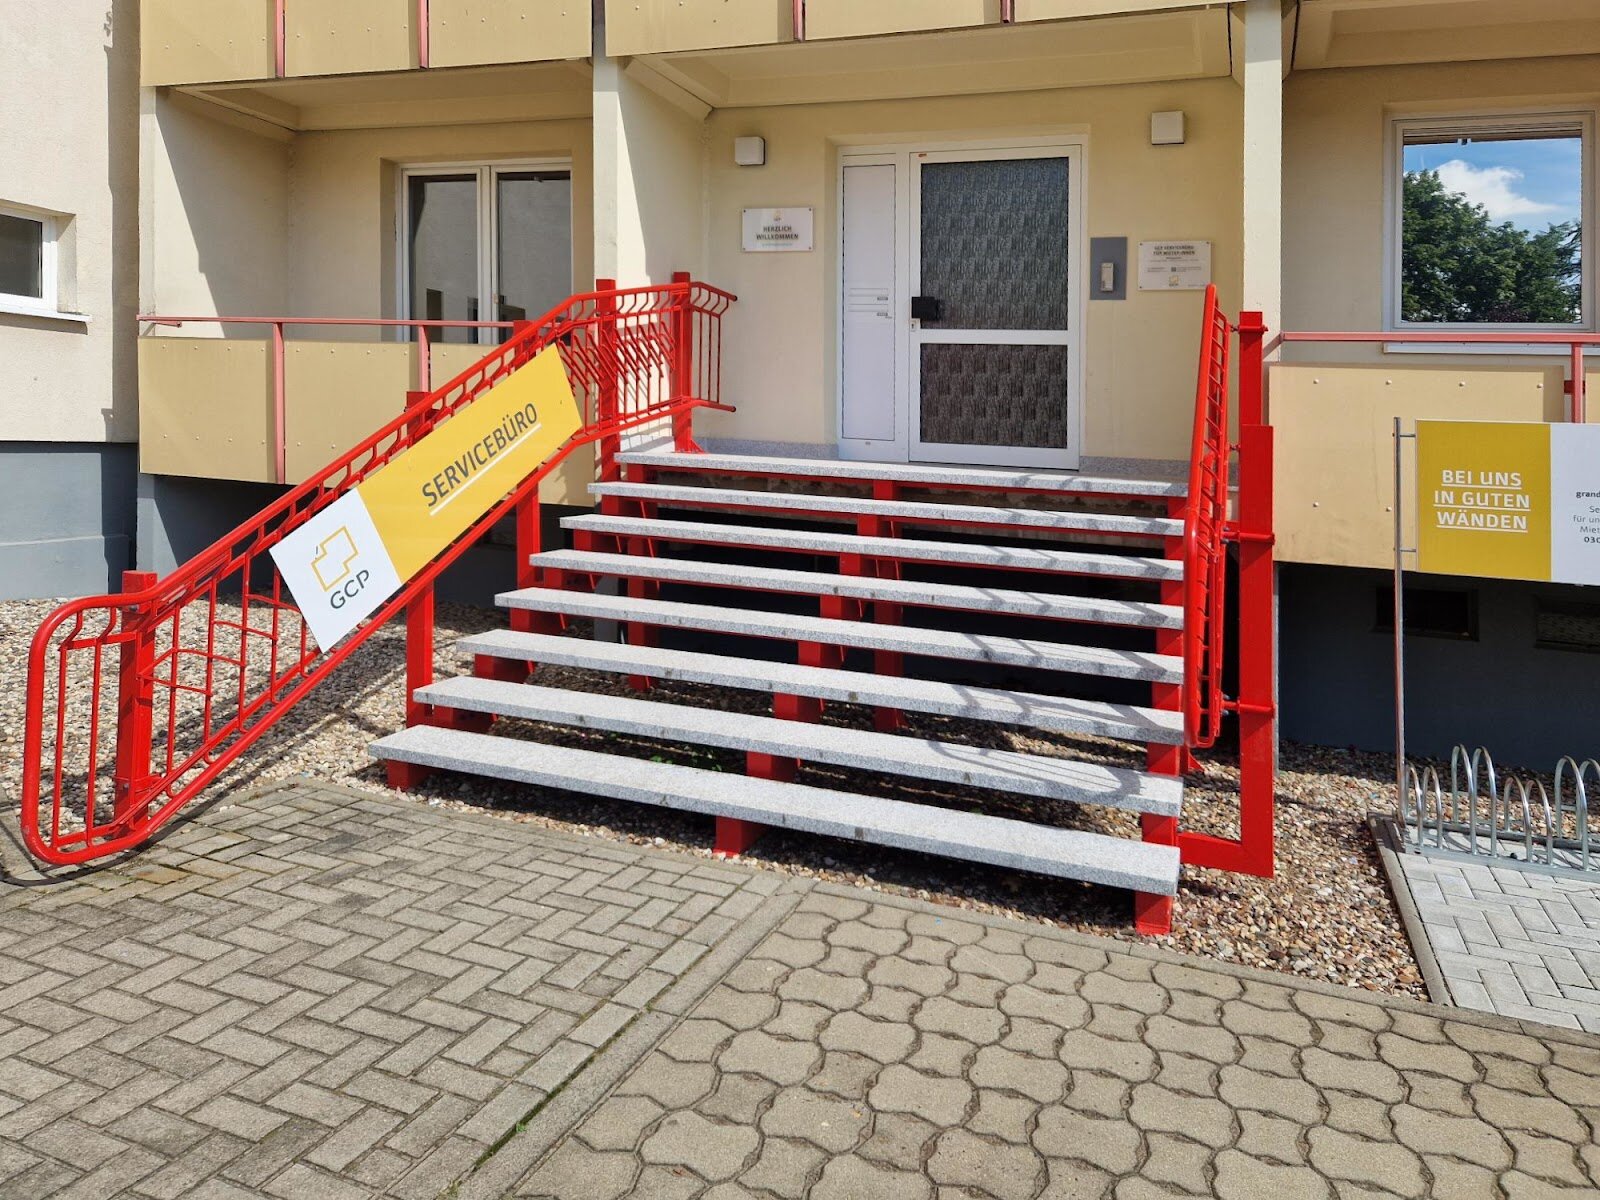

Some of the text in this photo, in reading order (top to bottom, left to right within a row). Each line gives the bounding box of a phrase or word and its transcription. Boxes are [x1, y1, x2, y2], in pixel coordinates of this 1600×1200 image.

[763, 225, 792, 233] HERZLICH
[422, 403, 538, 507] SERVICEBÜRO
[1442, 470, 1522, 487] BEI UNS
[1434, 490, 1530, 508] IN GUTEN
[1437, 509, 1527, 530] WÄNDEN
[1573, 514, 1586, 522] für
[330, 569, 370, 609] GCP
